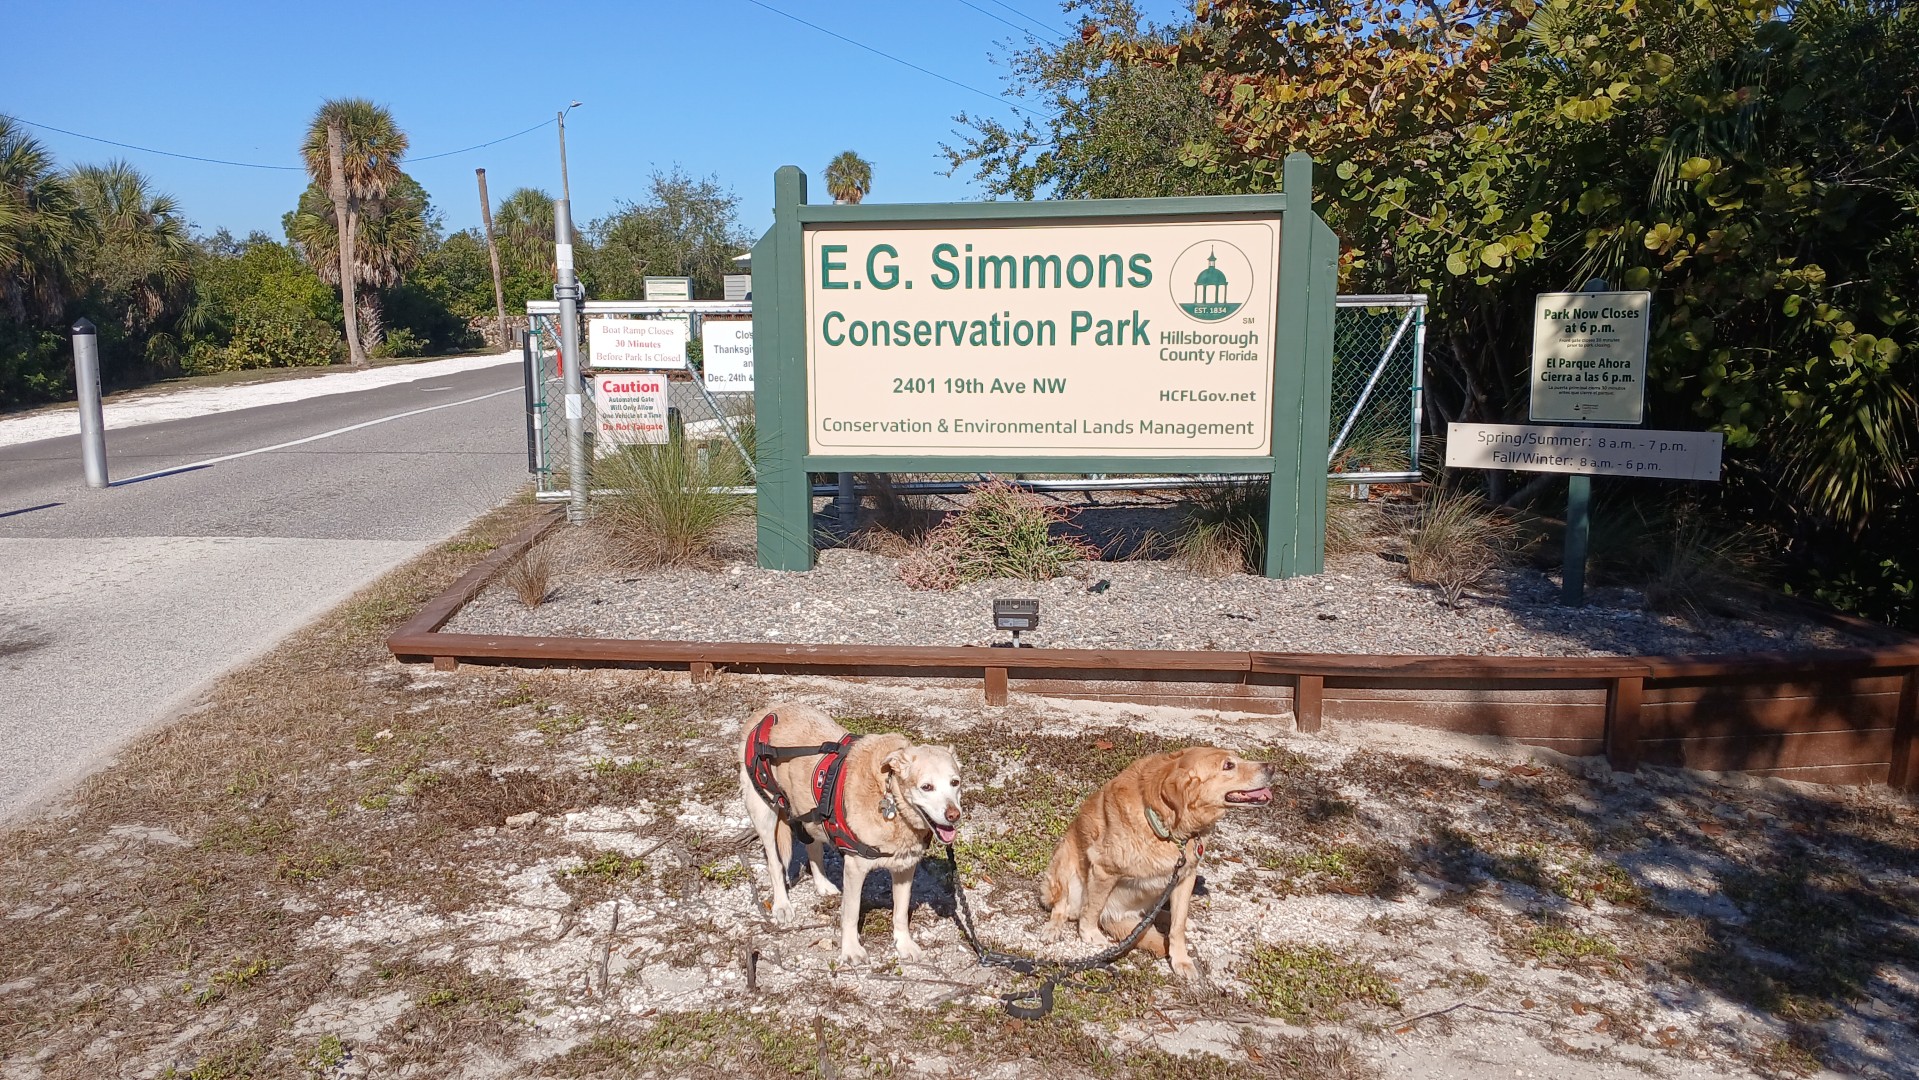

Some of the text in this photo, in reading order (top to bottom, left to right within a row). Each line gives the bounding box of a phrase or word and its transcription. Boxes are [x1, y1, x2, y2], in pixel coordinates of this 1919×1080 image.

[821, 243, 1153, 290] E.G. Simmons
[1544, 307, 1639, 320] Park Now Closes
[602, 326, 674, 336] Boat Ramp Closes
[735, 330, 753, 339] Clos
[822, 310, 1151, 347] Conservation Park
[1565, 322, 1615, 335] at 6 p.m.
[615, 340, 661, 348] 30 Minutes
[1160, 330, 1259, 348] Hillsborough
[714, 344, 753, 356] Thanksgi
[596, 352, 681, 362] Before Park Is Closed
[1160, 348, 1258, 365] County Florida
[1546, 358, 1631, 370] El Parque Ahora
[708, 373, 726, 382] Dec.
[728, 373, 746, 382] 24th
[1540, 372, 1572, 382] Cierra
[1585, 372, 1599, 382] las
[1602, 372, 1608, 382] 6
[1612, 374, 1635, 384] p.m.
[602, 380, 659, 392] Caution
[892, 377, 1067, 394] 2401 19th Ave NW
[1160, 390, 1257, 402] HCFLGov.net
[633, 423, 663, 431] Tailgate
[822, 417, 1254, 438] Conservation & Environmental Lands Management
[1477, 430, 1592, 447] Spring/Summer:
[1598, 438, 1606, 448] 8
[1609, 440, 1636, 450] a.m.
[1649, 440, 1656, 450] 7
[1660, 442, 1687, 453] p.m.
[1493, 451, 1573, 466] Fall/Winter:
[1580, 457, 1587, 467] 8
[1590, 459, 1614, 468] a.m.
[1626, 460, 1633, 469] 6
[1636, 461, 1662, 472] p.m.
